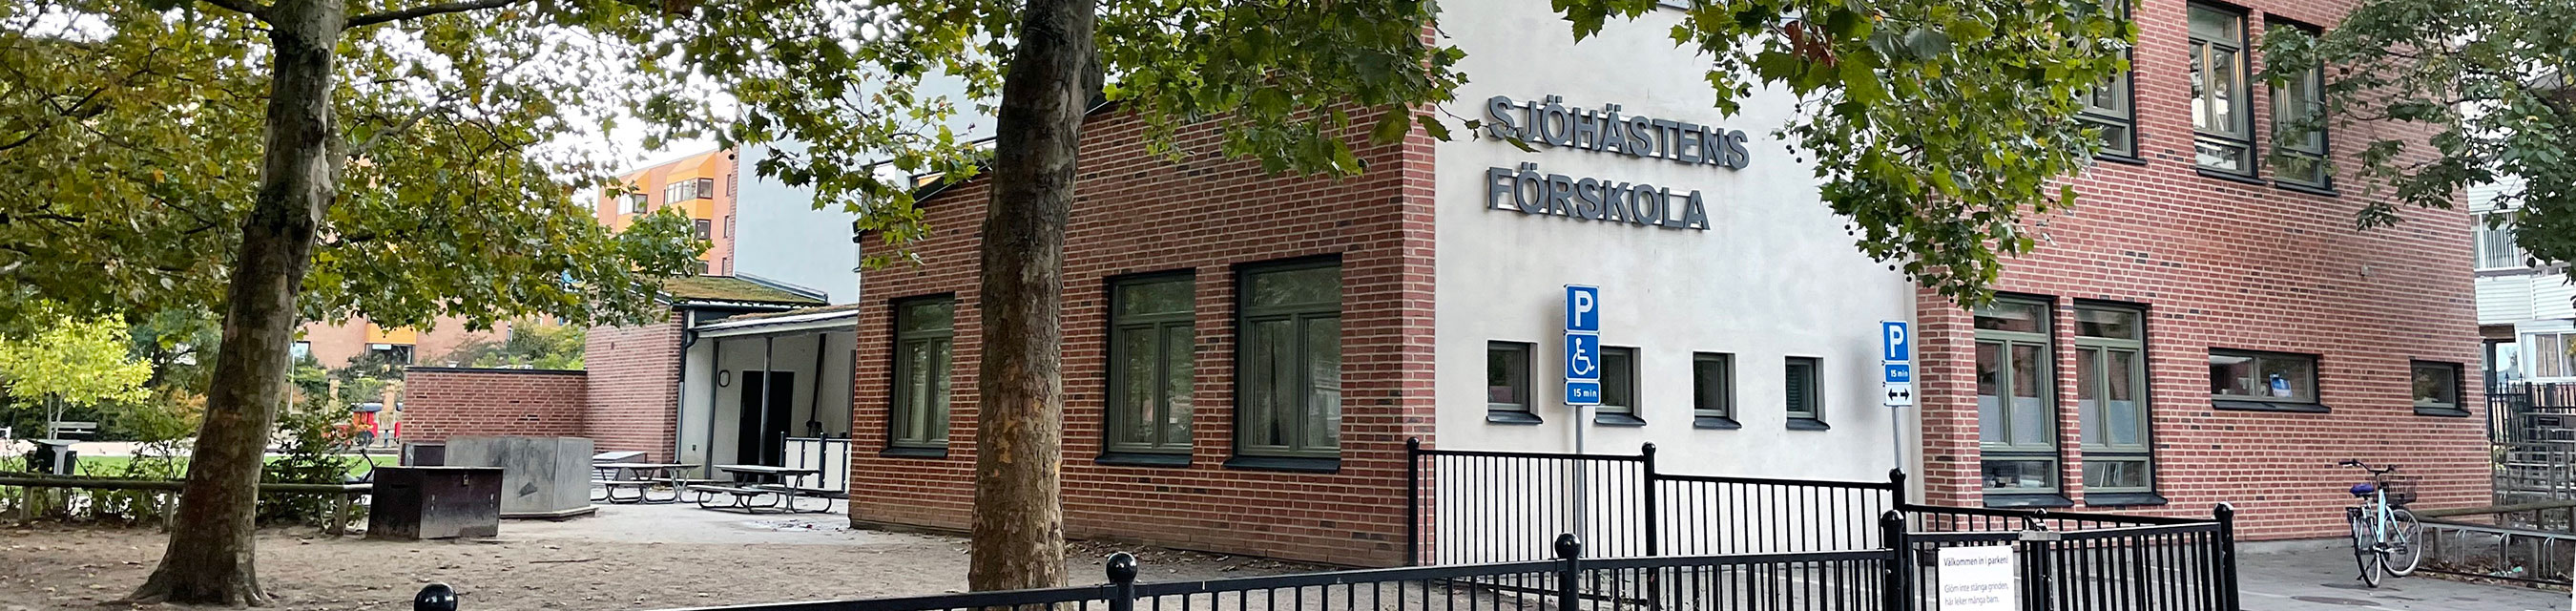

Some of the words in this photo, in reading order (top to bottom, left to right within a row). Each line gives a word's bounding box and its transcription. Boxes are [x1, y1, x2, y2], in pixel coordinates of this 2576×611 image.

[1488, 95, 1750, 170] SJÖHÄSTENS
[1488, 161, 1711, 230] FÖRSKOLA
[1574, 290, 1593, 327] P
[1889, 325, 1904, 358] P
[1573, 389, 1582, 398] 15
[1583, 389, 1597, 398] min
[1943, 558, 1978, 566] Välkommen
[1979, 557, 1984, 565] in
[1944, 584, 1959, 593] Glöm
[1971, 583, 1987, 592] stänga
[1945, 598, 1954, 606] här
[1955, 597, 1967, 605] leker
[1968, 597, 1985, 606] många
